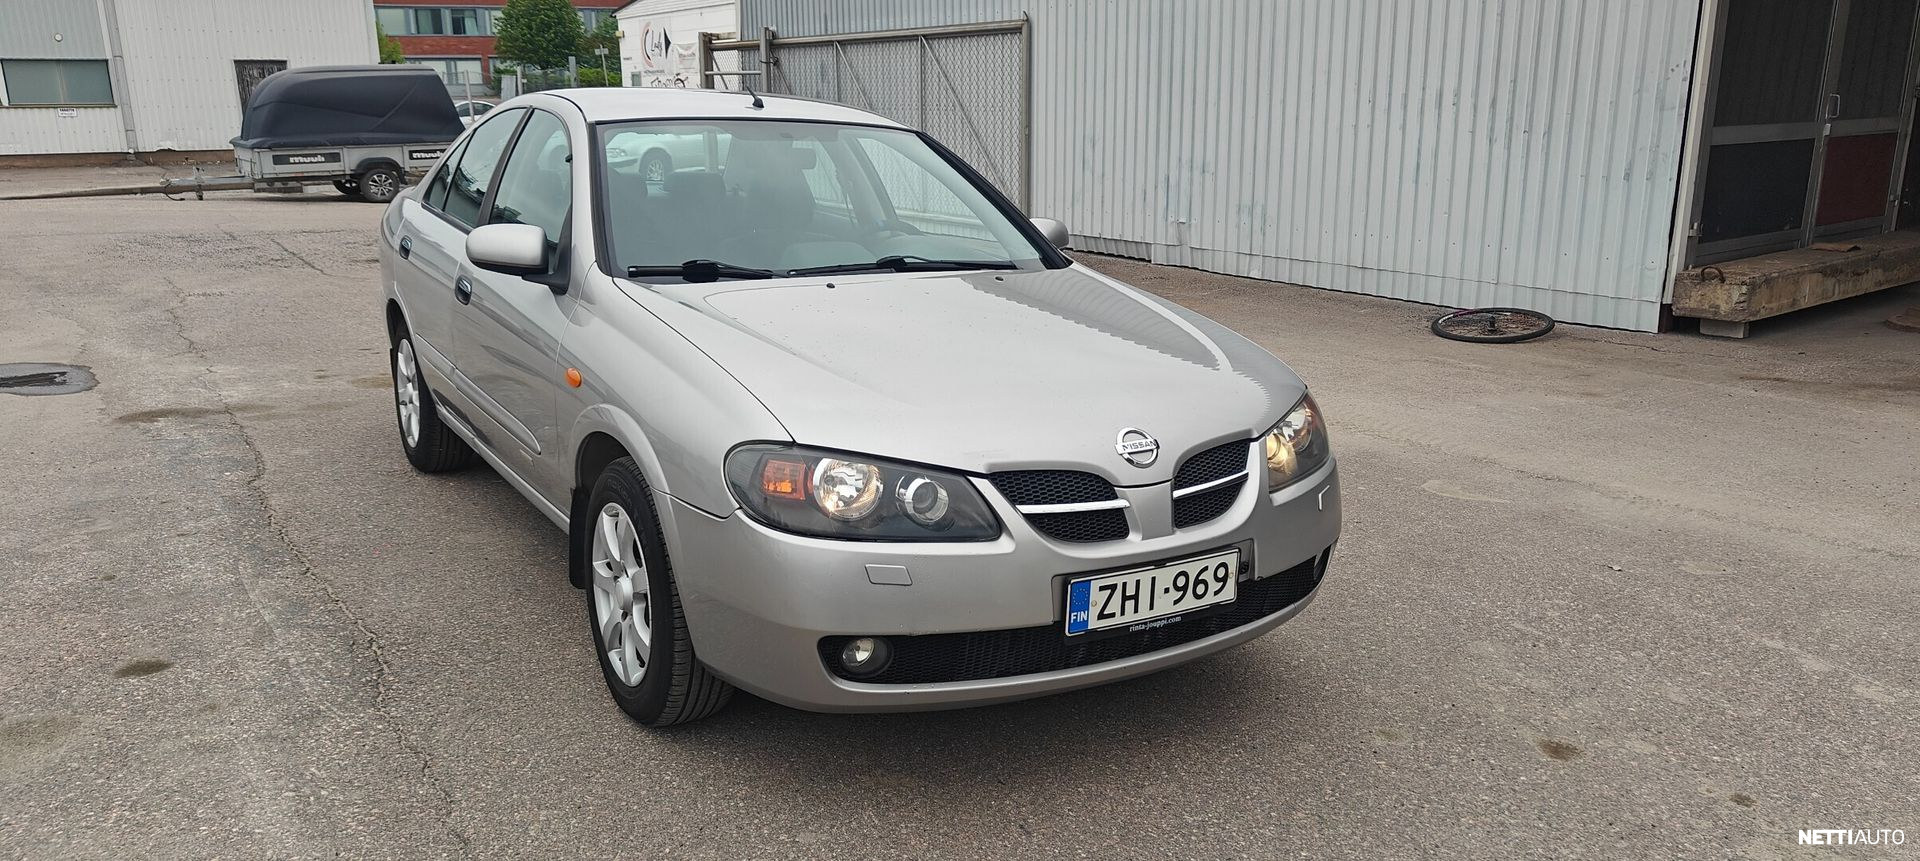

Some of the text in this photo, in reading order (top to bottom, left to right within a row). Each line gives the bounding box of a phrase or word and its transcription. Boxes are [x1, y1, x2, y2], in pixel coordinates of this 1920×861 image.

[1121, 440, 1157, 451] NISSAN
[1097, 561, 1230, 621] ZHI-969
[1070, 610, 1088, 624] FIN
[1129, 616, 1182, 632] rinta-jouppi.com
